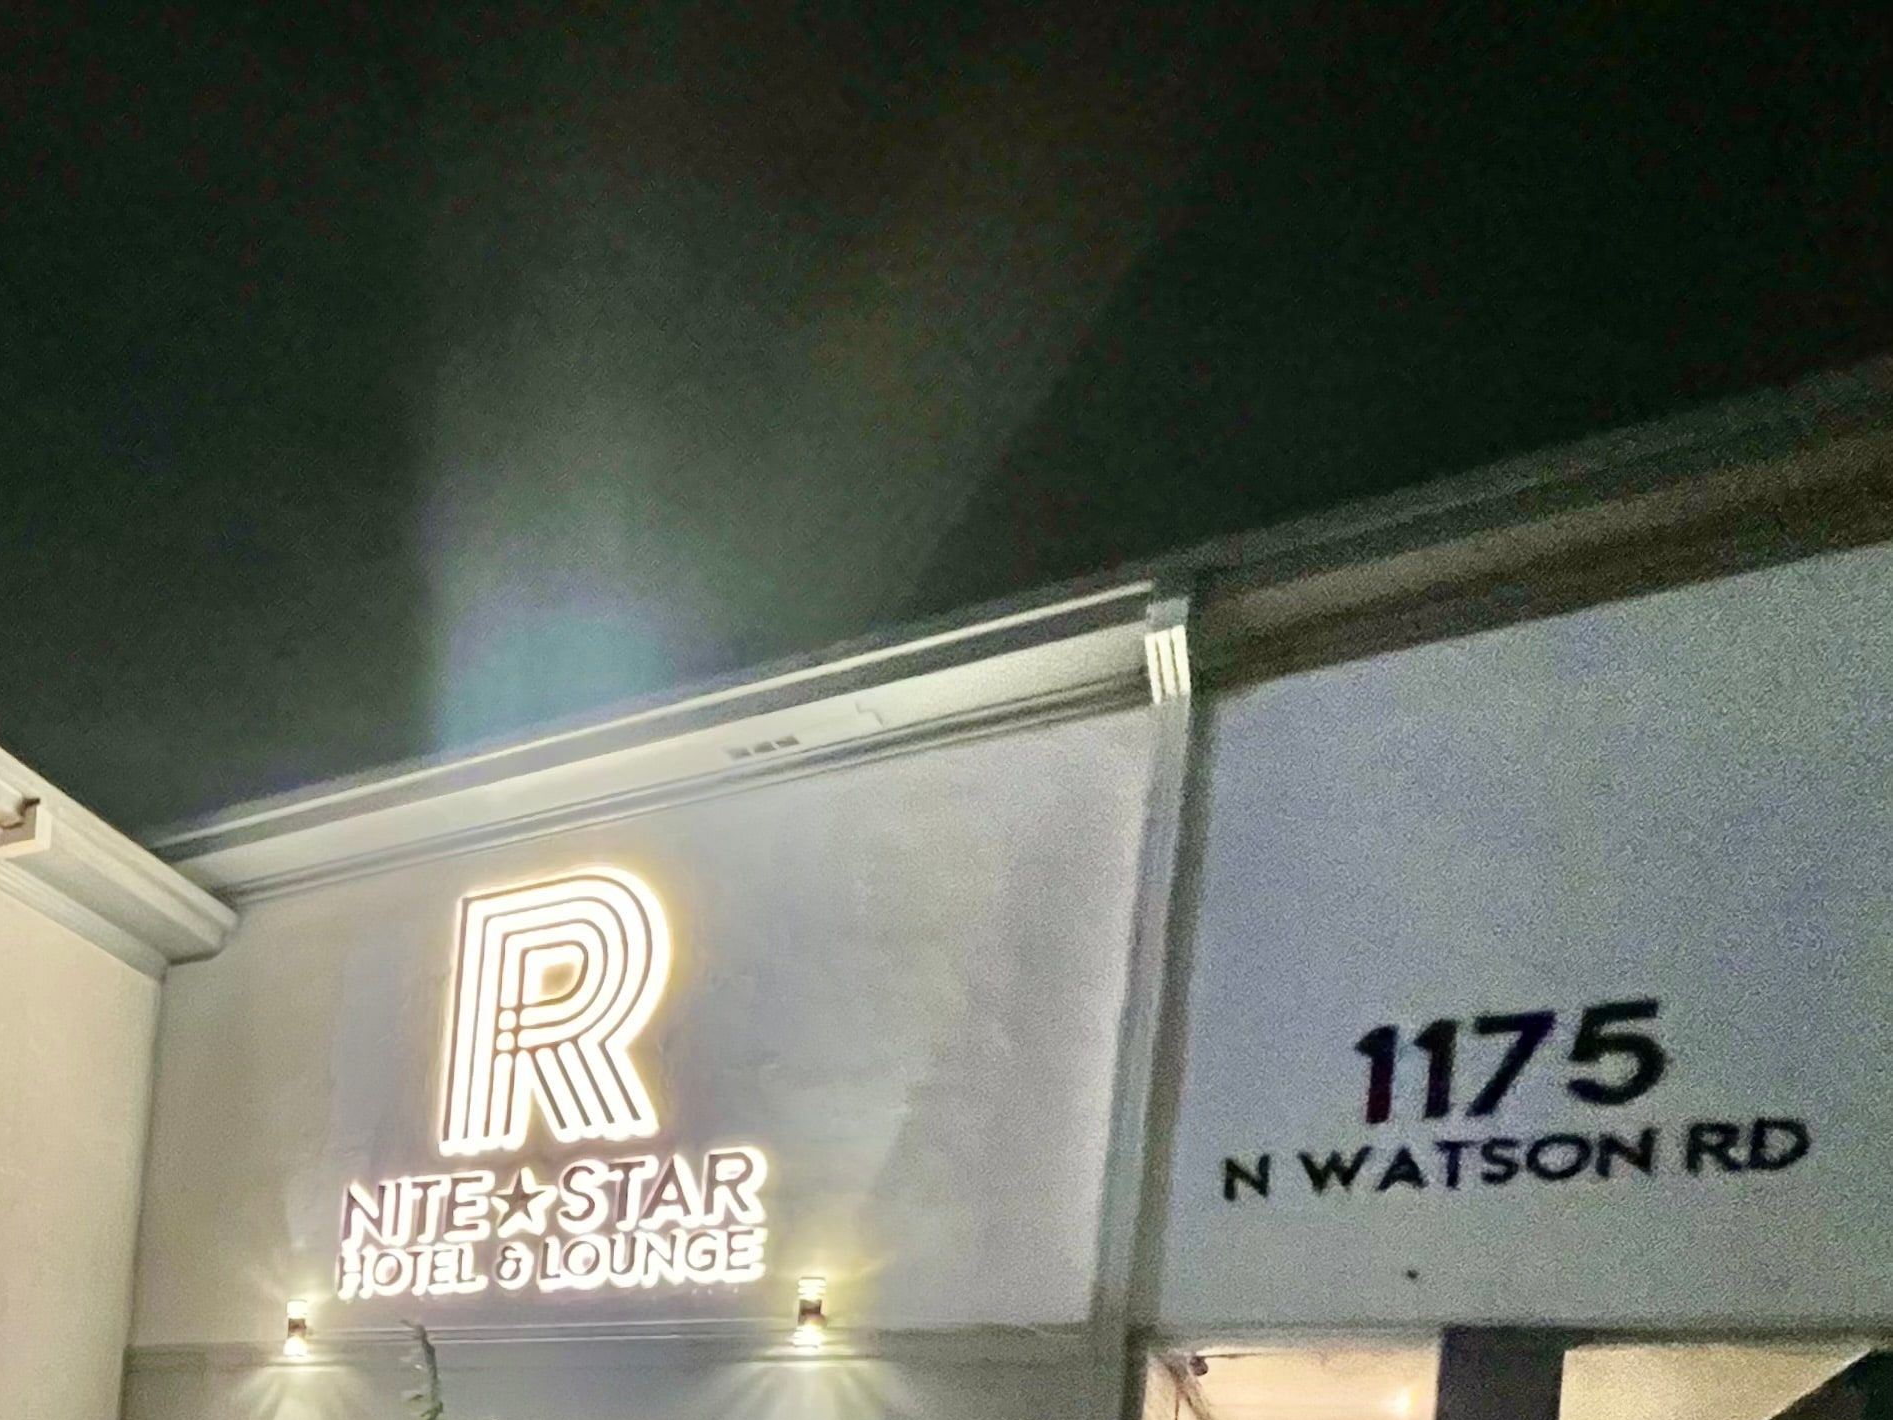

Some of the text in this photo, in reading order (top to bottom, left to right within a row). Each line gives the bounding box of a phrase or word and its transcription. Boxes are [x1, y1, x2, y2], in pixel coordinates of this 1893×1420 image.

[1354, 1000, 1665, 1124] 1175
[342, 1148, 767, 1246] NITE STAR
[1222, 1117, 1813, 1201] N WATSON RD
[337, 1228, 767, 1299] HOTEL & LOUNGE
